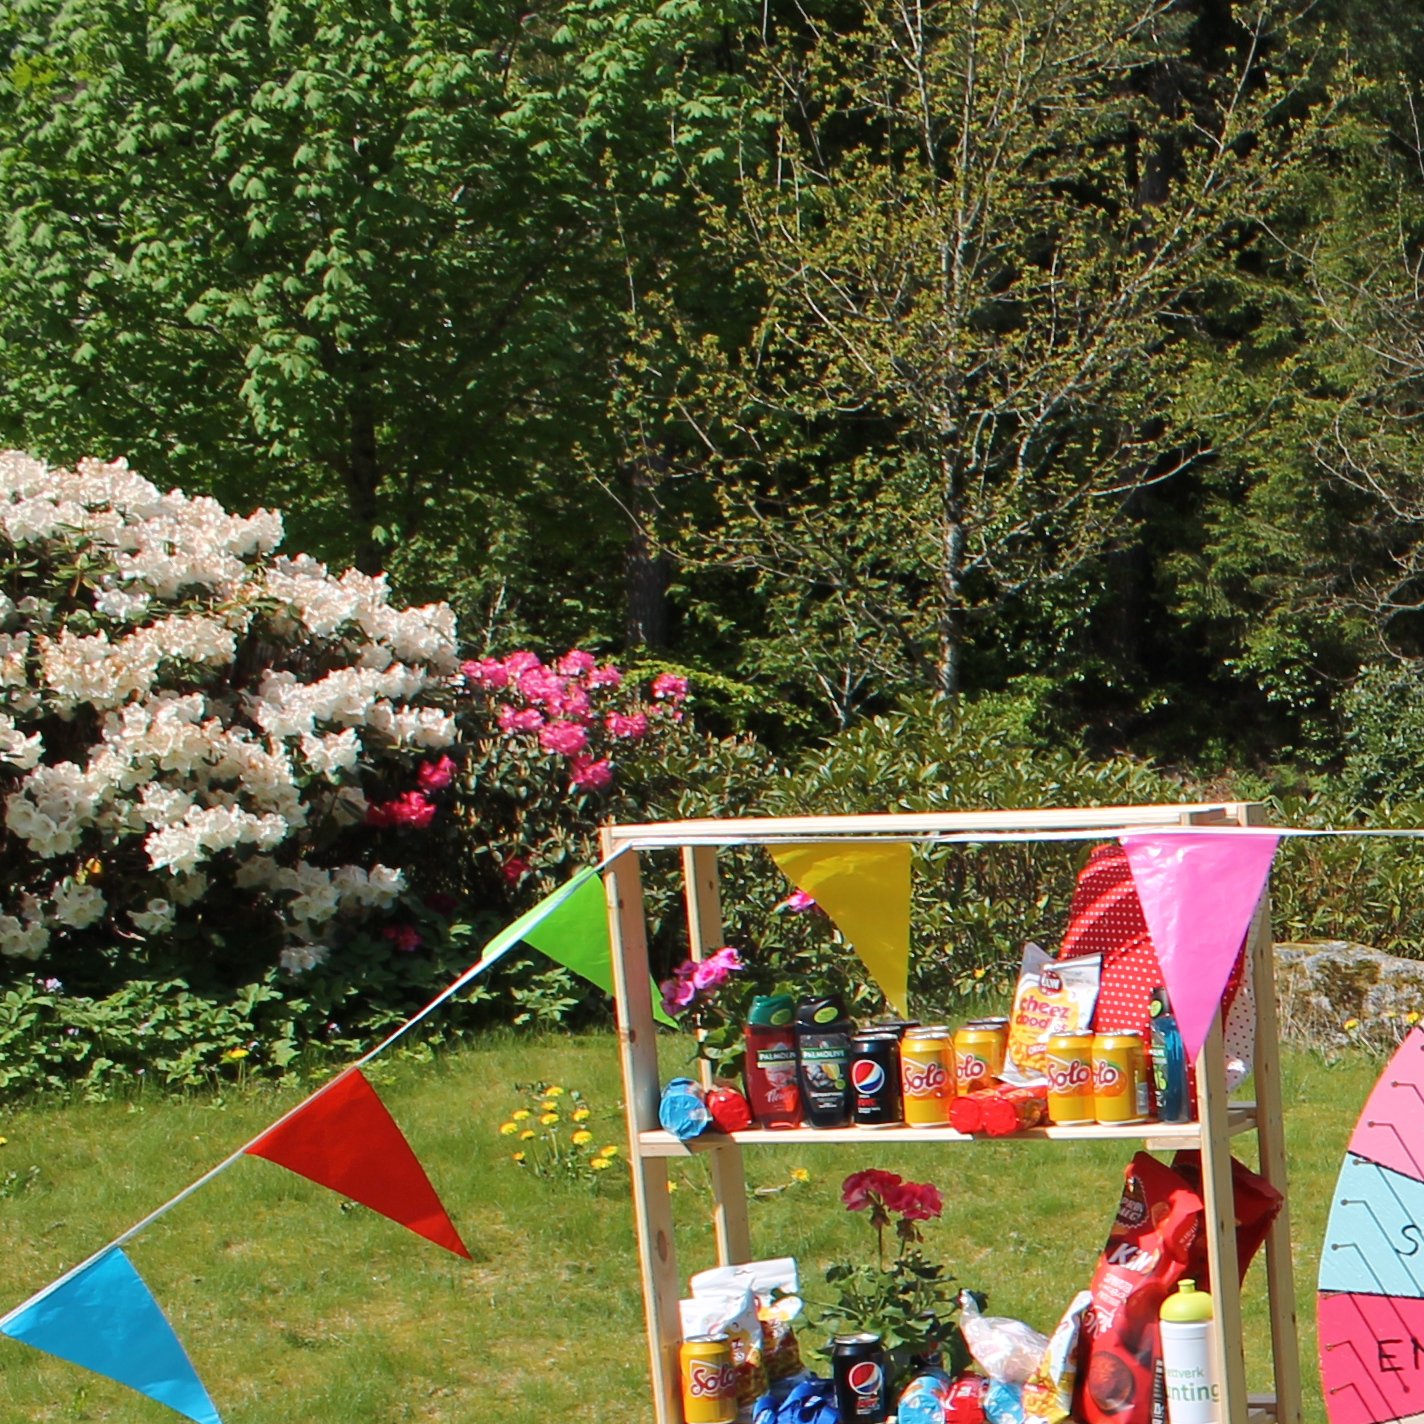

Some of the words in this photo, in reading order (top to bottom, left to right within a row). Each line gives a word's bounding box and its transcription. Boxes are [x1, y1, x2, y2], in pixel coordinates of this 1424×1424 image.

[1020, 996, 1071, 1020] cheez
[904, 1063, 947, 1093] Solo
[956, 1053, 986, 1079] olo
[690, 1363, 737, 1397] Solo
[1166, 1382, 1220, 1403] nting
